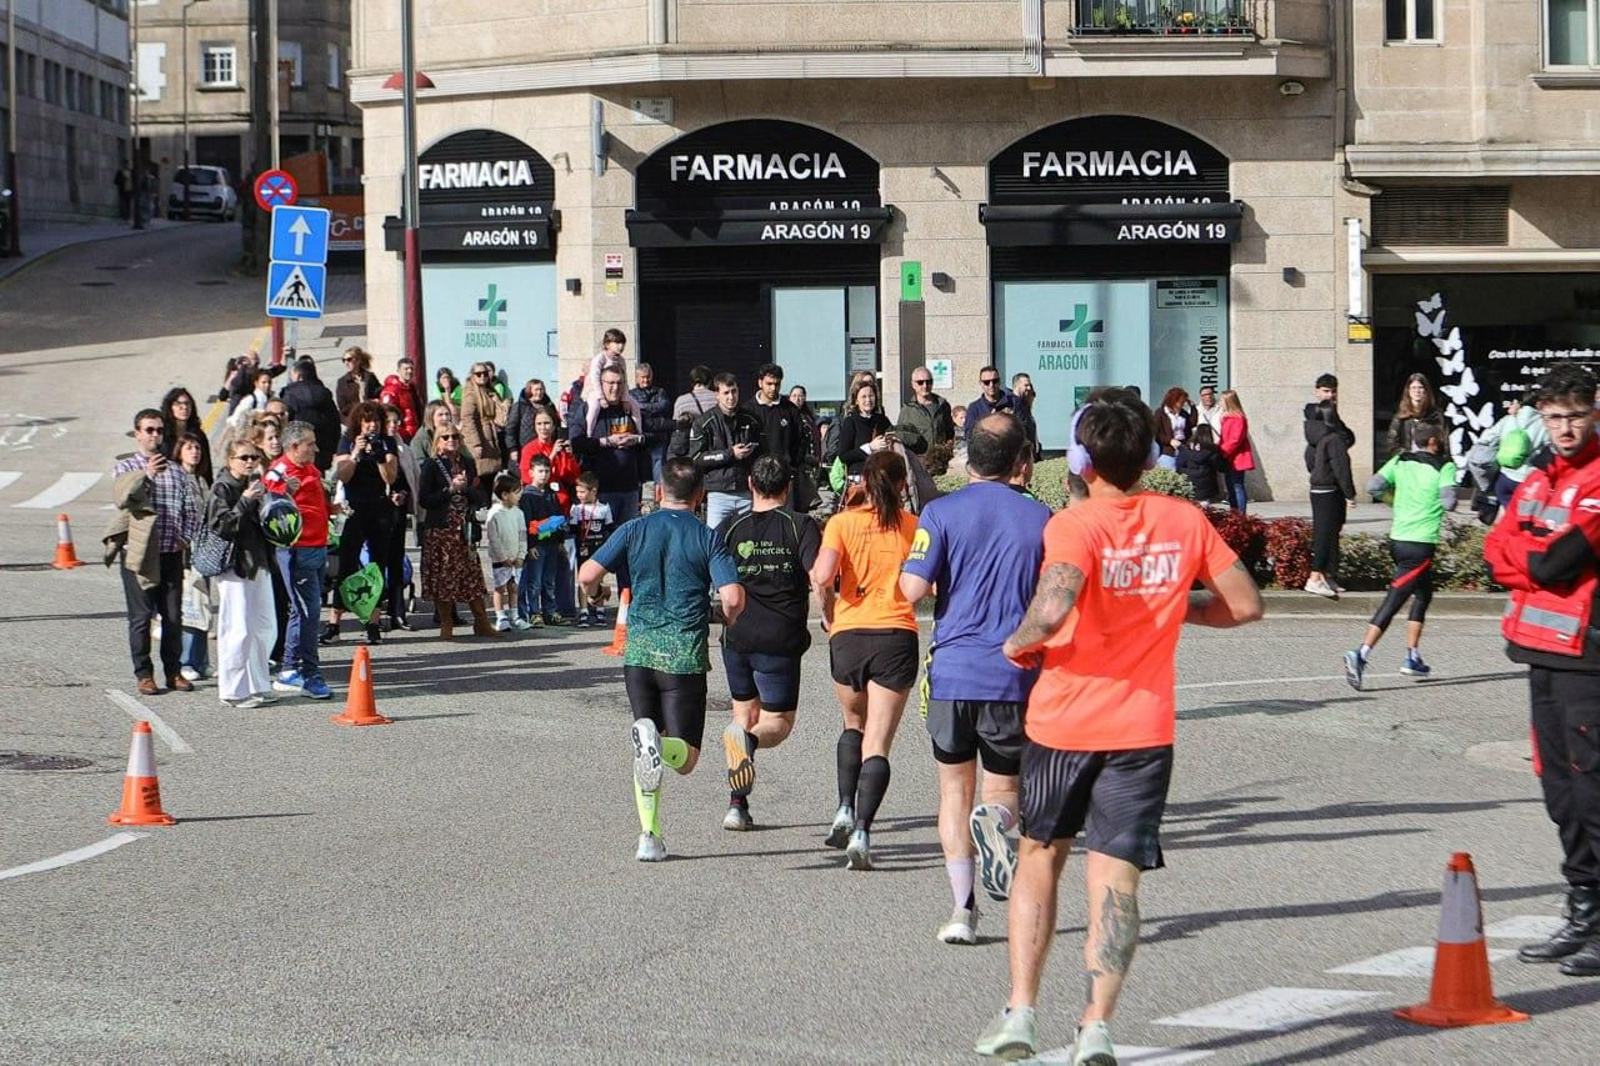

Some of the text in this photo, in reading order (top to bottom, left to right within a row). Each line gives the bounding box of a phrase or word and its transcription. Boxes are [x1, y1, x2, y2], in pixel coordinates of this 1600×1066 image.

[670, 152, 846, 181] FARMACIA
[1022, 150, 1196, 177] FARMACIA
[418, 159, 533, 189] FARMACIA
[462, 227, 537, 246] ARAGÓN 19
[761, 221, 871, 240] ARAGÓN 19
[1117, 221, 1226, 240] ARAGÓN 19
[1038, 352, 1088, 371] ARAGÓN
